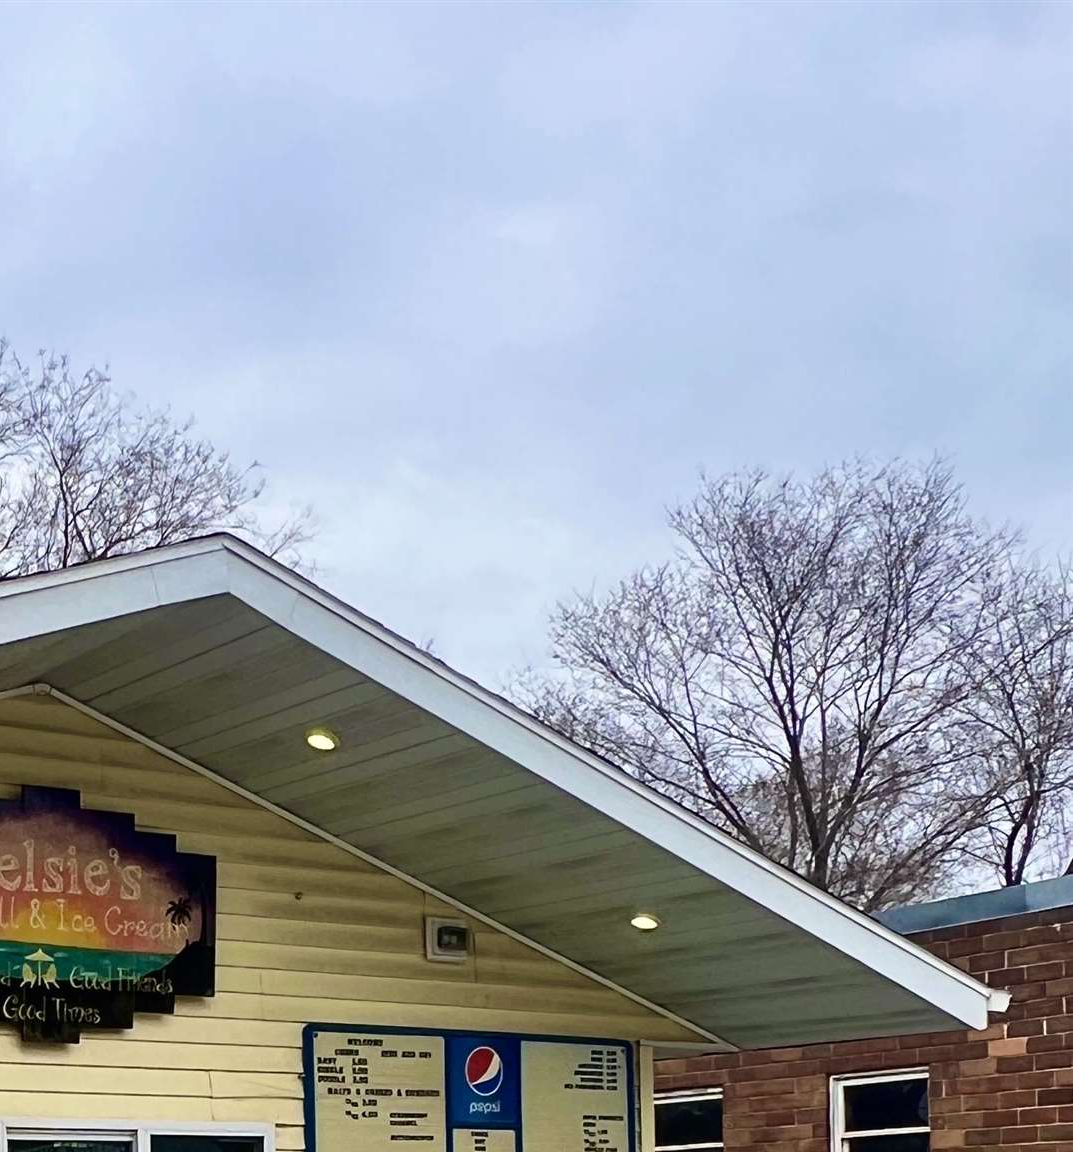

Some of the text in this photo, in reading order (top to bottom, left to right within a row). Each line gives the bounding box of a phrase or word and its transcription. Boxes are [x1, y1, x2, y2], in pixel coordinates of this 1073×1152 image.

[29, 898, 47, 931] &
[56, 898, 98, 932] Ice
[104, 905, 190, 940] Cream
[2, 992, 47, 1022] Good
